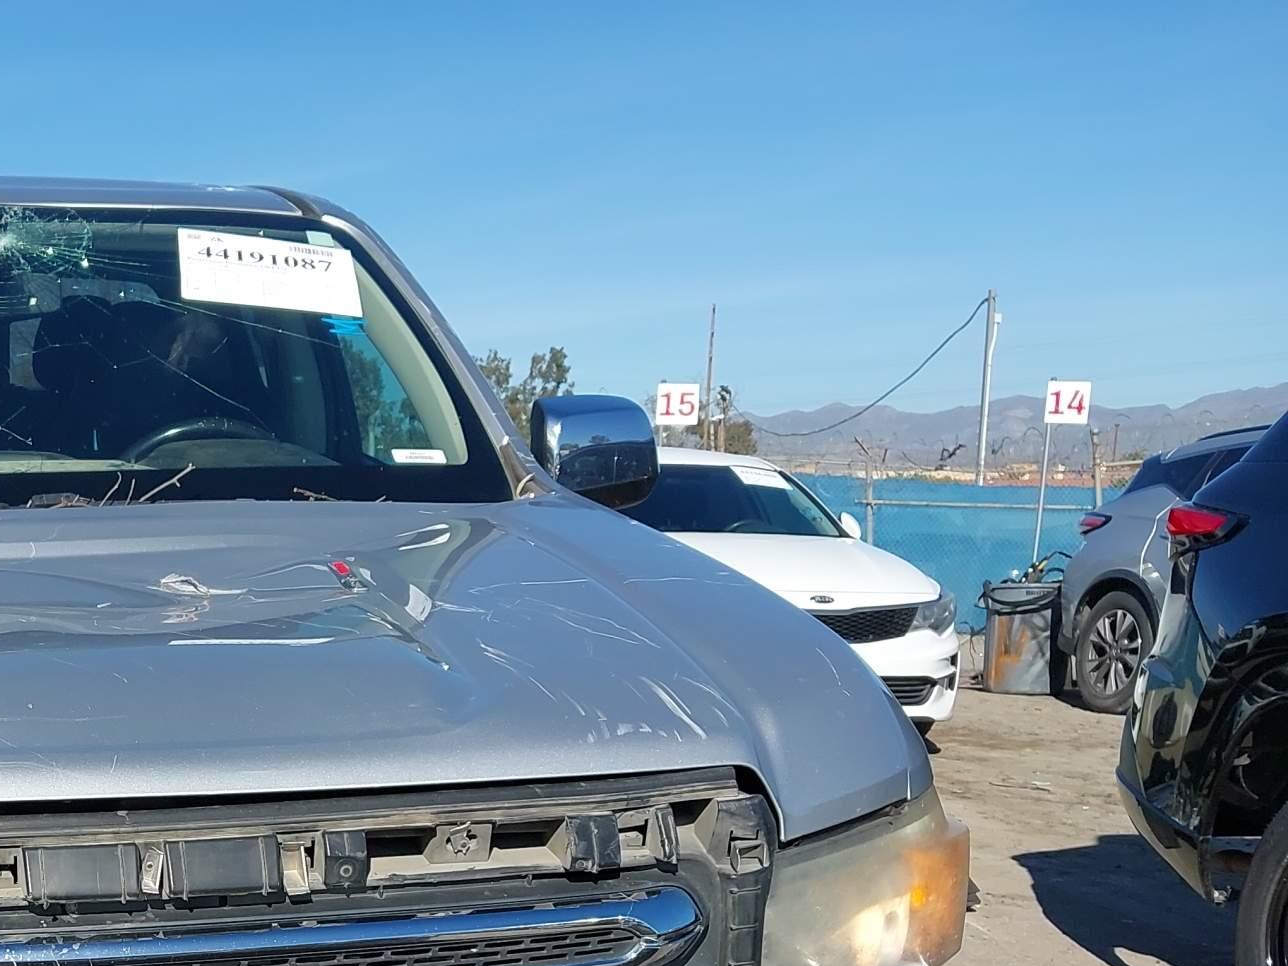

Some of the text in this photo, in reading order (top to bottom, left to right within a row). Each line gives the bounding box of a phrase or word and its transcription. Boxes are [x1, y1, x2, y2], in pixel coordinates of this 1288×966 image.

[198, 246, 332, 272] 44191087
[659, 392, 695, 416] 15
[1048, 390, 1086, 415] 14
